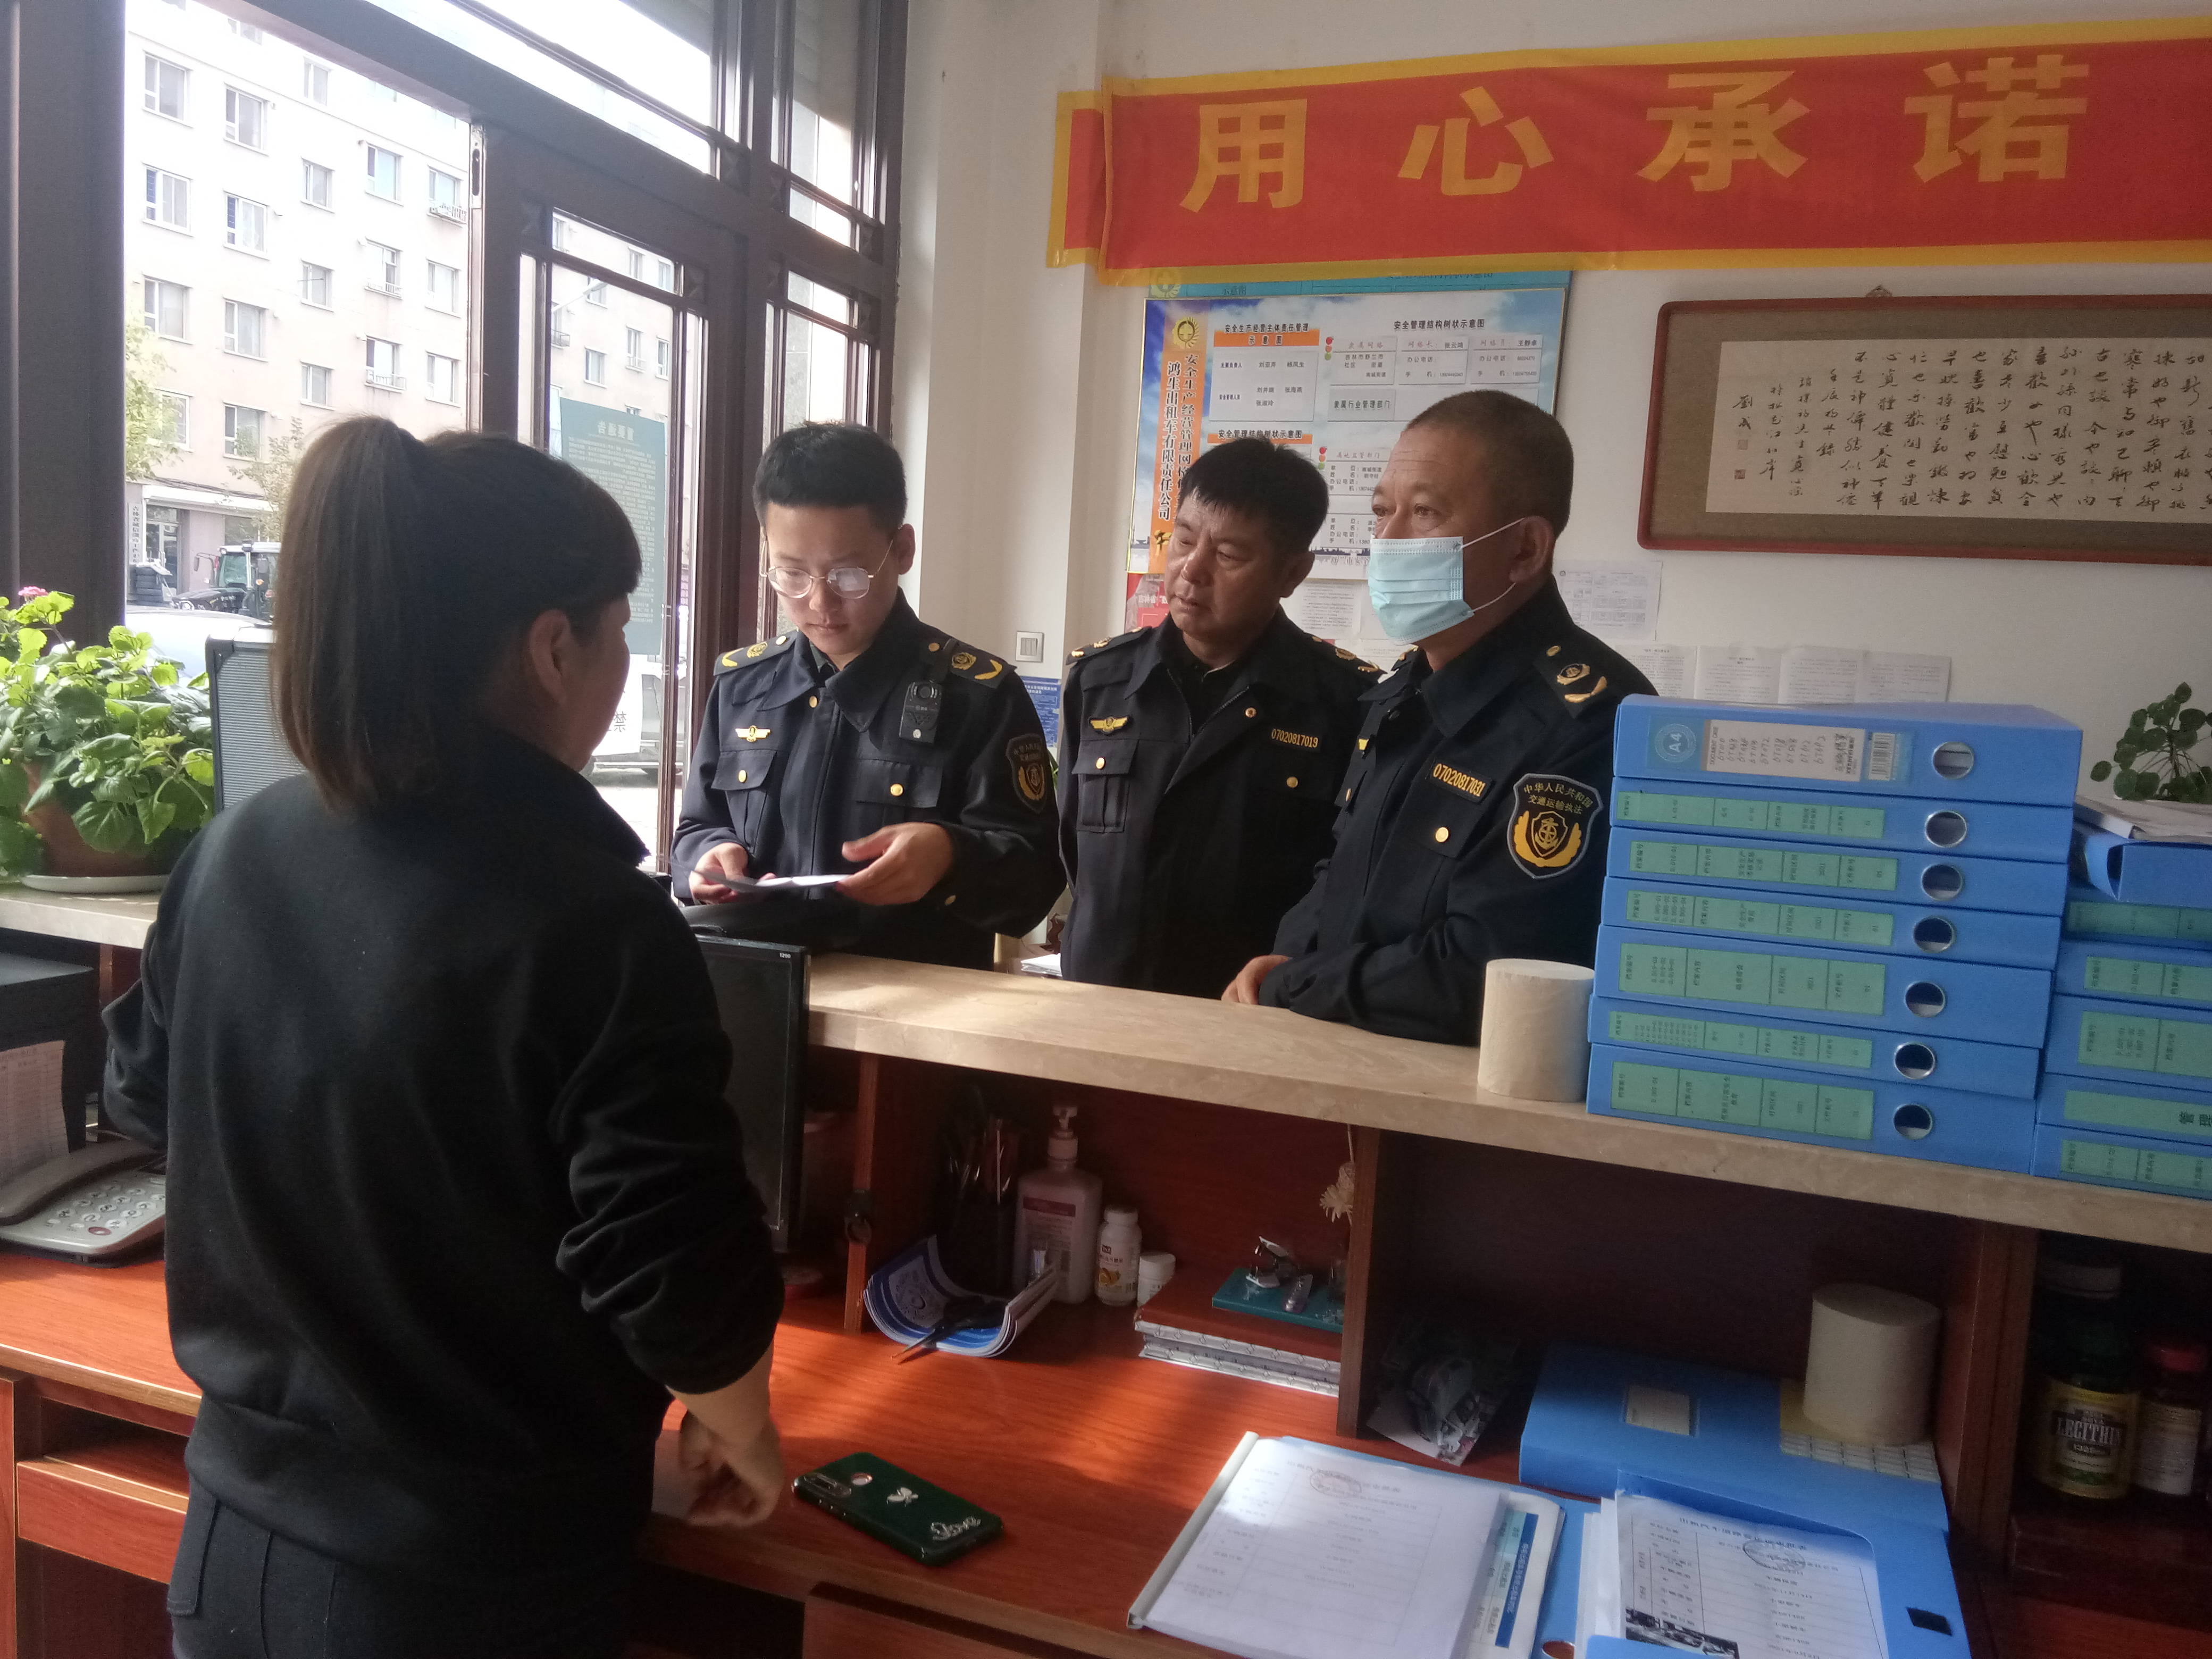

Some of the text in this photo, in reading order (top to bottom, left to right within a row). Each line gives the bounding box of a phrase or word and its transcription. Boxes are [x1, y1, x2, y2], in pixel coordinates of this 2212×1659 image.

[1179, 54, 2090, 213] 用心承诺
[1225, 323, 1309, 333] 安全生产经营主体责任管理
[1394, 319, 1485, 330] 安全管理结构树状示意图
[1249, 336, 1283, 345] 示意图
[1158, 362, 1182, 520] 鸿生出租车有限责任公司
[1271, 728, 1318, 748] 07020817019
[1669, 733, 1682, 753] A4
[1432, 763, 1486, 797] 07020817031
[1523, 782, 1593, 809] 中华人民共和国
[1528, 794, 1583, 815] 交通运输执法
